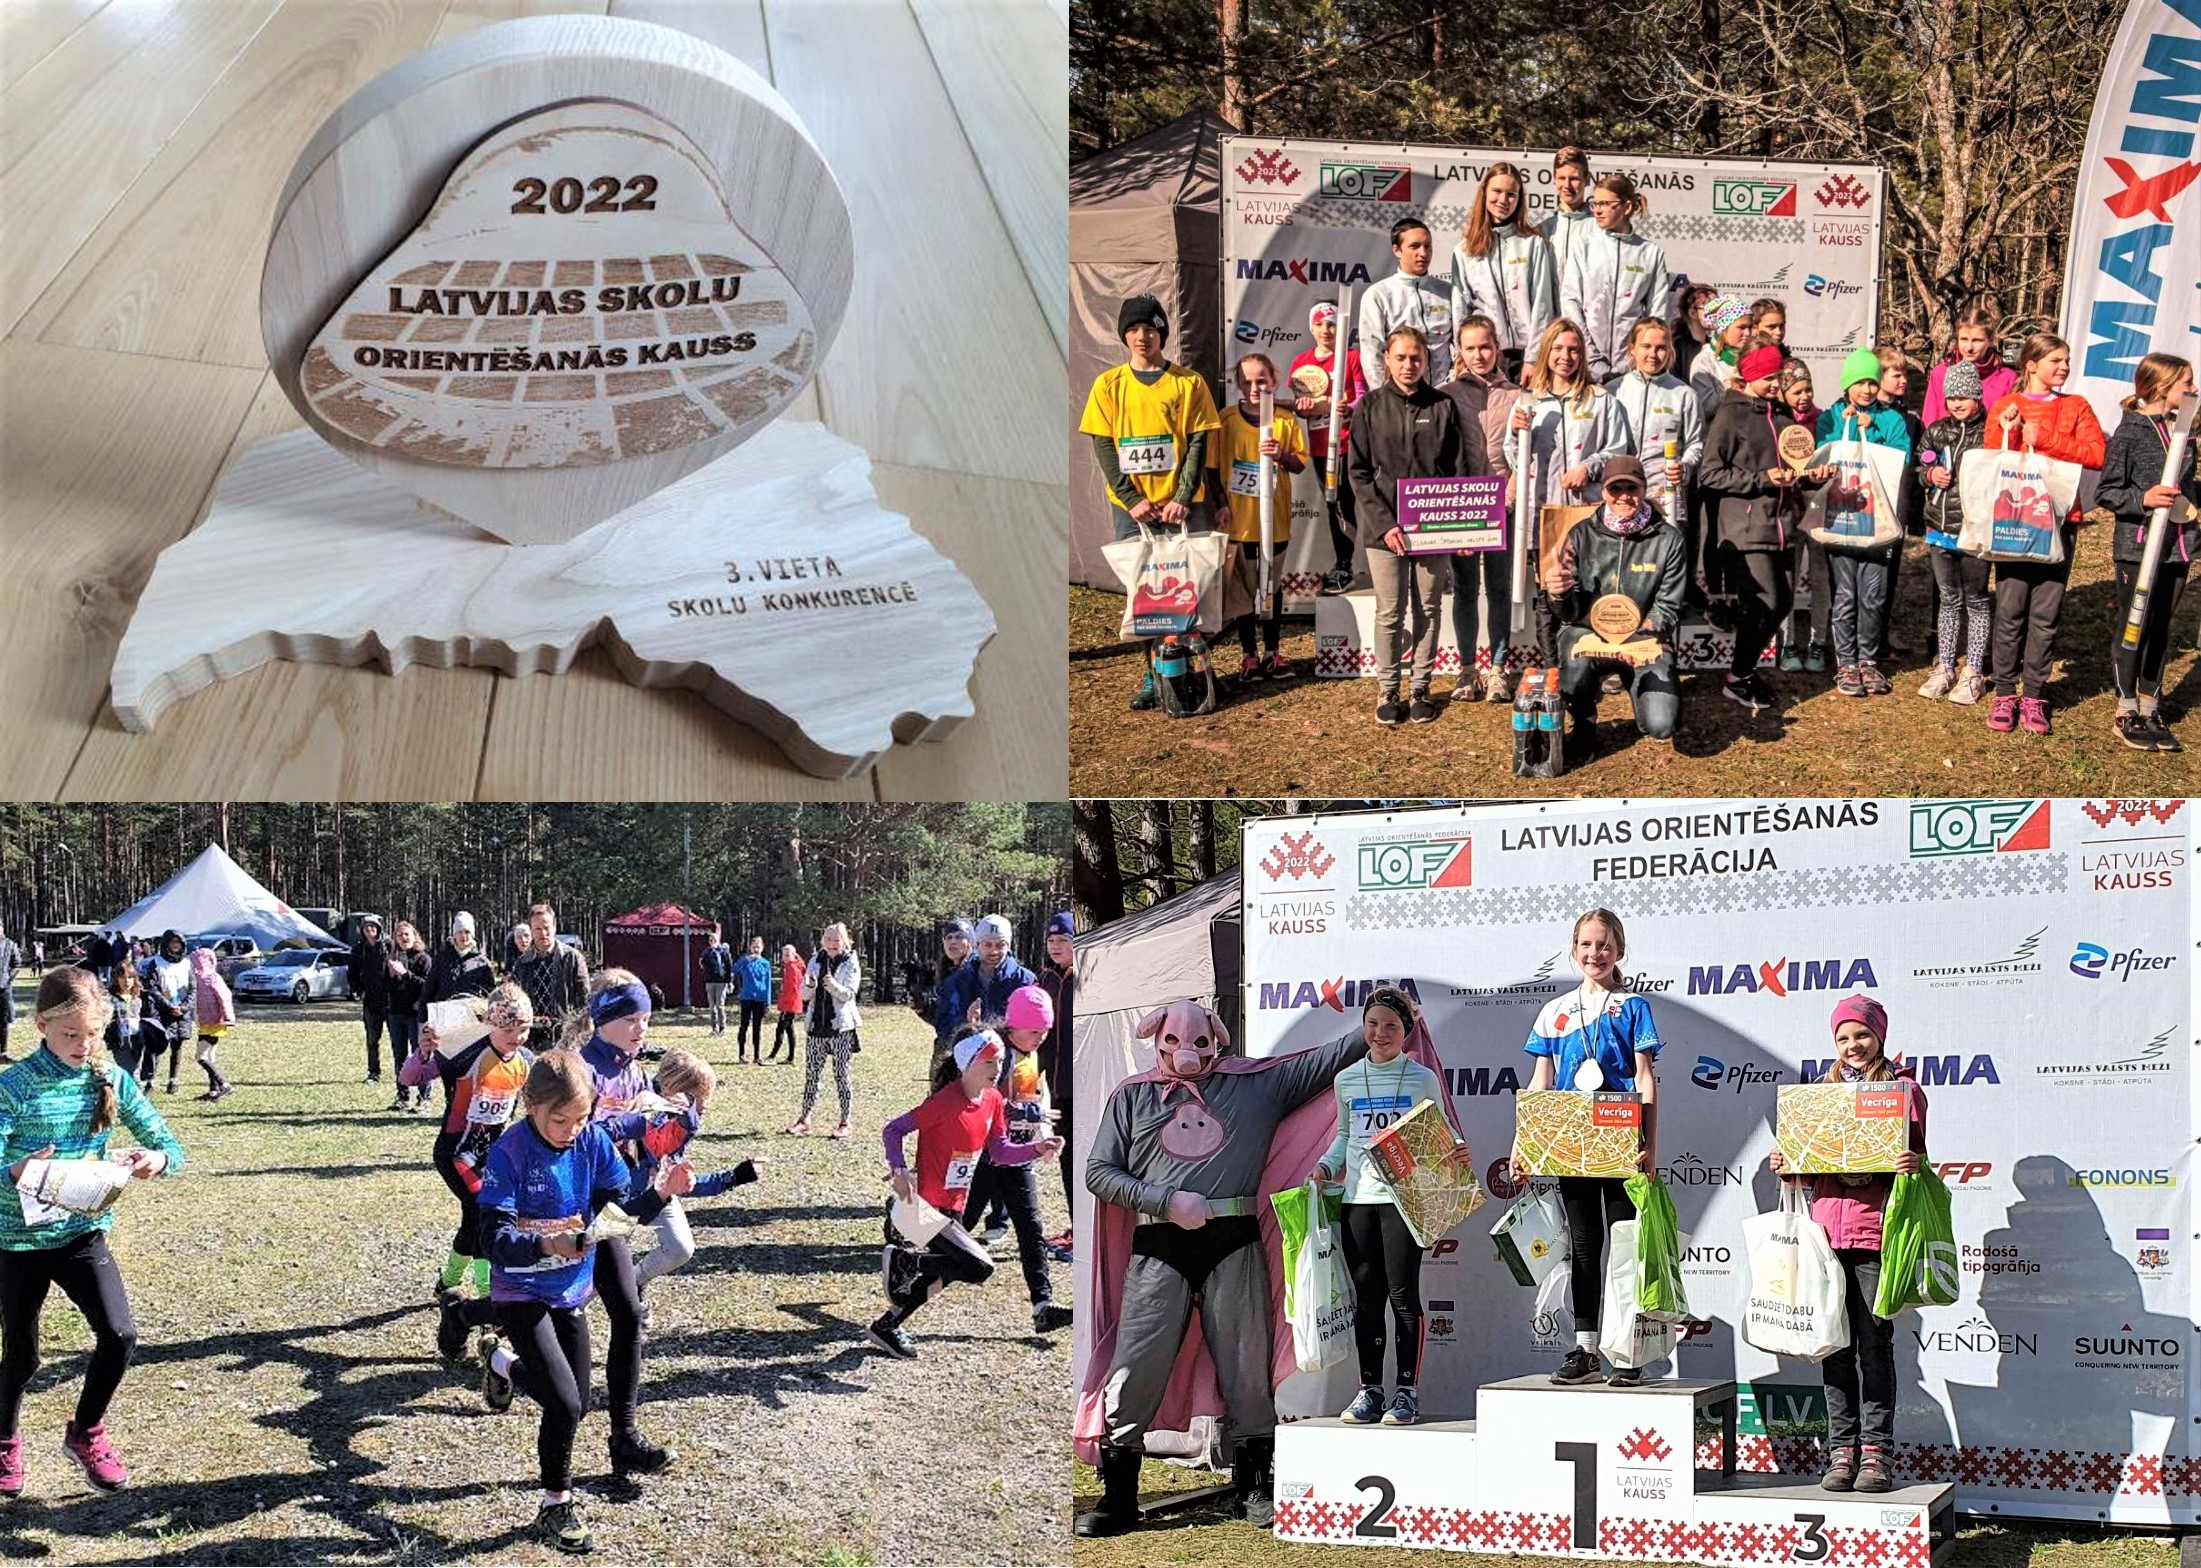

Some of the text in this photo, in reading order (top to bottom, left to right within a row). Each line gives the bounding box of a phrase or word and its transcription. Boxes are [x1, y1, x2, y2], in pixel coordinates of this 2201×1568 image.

[1257, 167, 1279, 177] 2022
[1434, 164, 1531, 184] LATVS
[1320, 167, 1400, 197] LOF
[2083, 0, 2201, 382] MAXIM
[511, 174, 659, 215] 2022
[1713, 183, 1788, 213] LOF
[1833, 191, 1853, 200] 2022
[1236, 200, 1301, 215] LATVIJAS
[1244, 213, 1294, 226] KAUSS
[1812, 222, 1870, 235] LATVIJAS
[1819, 234, 1863, 246] KAUSS
[1236, 257, 1372, 285] MAXIMA
[388, 276, 742, 317] LATVIJAS SKOLU
[1827, 280, 1863, 300] Pfizer
[1261, 326, 1302, 348] Pfizer
[353, 331, 758, 373] ORIENTĒŠANĀS KAUSS
[1128, 447, 1166, 464] 444
[2001, 469, 2042, 480] MAXIMA
[1404, 482, 1500, 495] LATVIJAS SKOLU
[1407, 495, 1497, 508] ORIENTĒŠANĀS
[1419, 510, 1488, 522] KAUSS 2022
[1995, 526, 2029, 536] PALDIES
[723, 556, 842, 584] 3.VIETA
[667, 581, 919, 618] SKOLU KONKURENCĒ
[1693, 634, 1714, 662] 3
[1501, 799, 1878, 851] LATVIJAS ORIENTĒŠANĀS
[1910, 801, 2035, 853] LOF
[1284, 857, 1310, 868] 2022
[1358, 843, 1459, 886] LOF
[1593, 848, 1778, 881] FEDERĀCIJA
[2082, 850, 2185, 872] LATVIJAS
[2094, 871, 2172, 891] KAUSS
[1259, 901, 1336, 919] LATVIJAS
[1268, 918, 1327, 935] KAUSS
[1913, 966, 1966, 977] LATVIJAS
[1969, 964, 2010, 974] VALSTS
[2110, 948, 2177, 982] Pfizer
[1623, 972, 1675, 993] Pfizer
[1687, 956, 1878, 997] MAXIMA
[1930, 981, 1960, 989] KOKSNE
[1967, 979, 1988, 987] STĀDI
[1450, 987, 1494, 996] LATVIJAS
[1497, 986, 1530, 994] VALSTS
[2036, 1064, 2091, 1075] LATVIJAS
[2095, 1063, 2137, 1072] VALSTS
[1444, 1067, 1521, 1096] IMA
[1726, 1063, 1783, 1094] Pfizer
[2123, 1077, 2152, 1085] ATPŪTA
[1870, 1084, 1886, 1092] 1500
[1860, 1097, 1898, 1108] Vecrīga
[1598, 1107, 1633, 1118] Vecrīga
[1386, 1141, 1406, 1174] Vecrīga
[1930, 1162, 1992, 1184] FP
[2075, 1169, 2169, 1185] FONONS
[1961, 1244, 2019, 1258] Radošā
[1962, 1259, 2041, 1276] tipogrāfija
[1785, 1305, 1814, 1316] DABU
[1751, 1313, 1761, 1323] IR
[1786, 1319, 1814, 1332] DABĀ
[1912, 1330, 2038, 1356] VENDEN
[2075, 1337, 2179, 1356] SUUNTO
[2075, 1361, 2121, 1369] CONQUERING
[1282, 1483, 1310, 1497] LOF
[1616, 1475, 1673, 1488] LATVIJAS
[1555, 1441, 1597, 1549] 1
[1623, 1488, 1666, 1500] KAUSS
[1354, 1475, 1397, 1538] 2
[1881, 1511, 1915, 1527] LOF
[1794, 1513, 1828, 1560] 3
